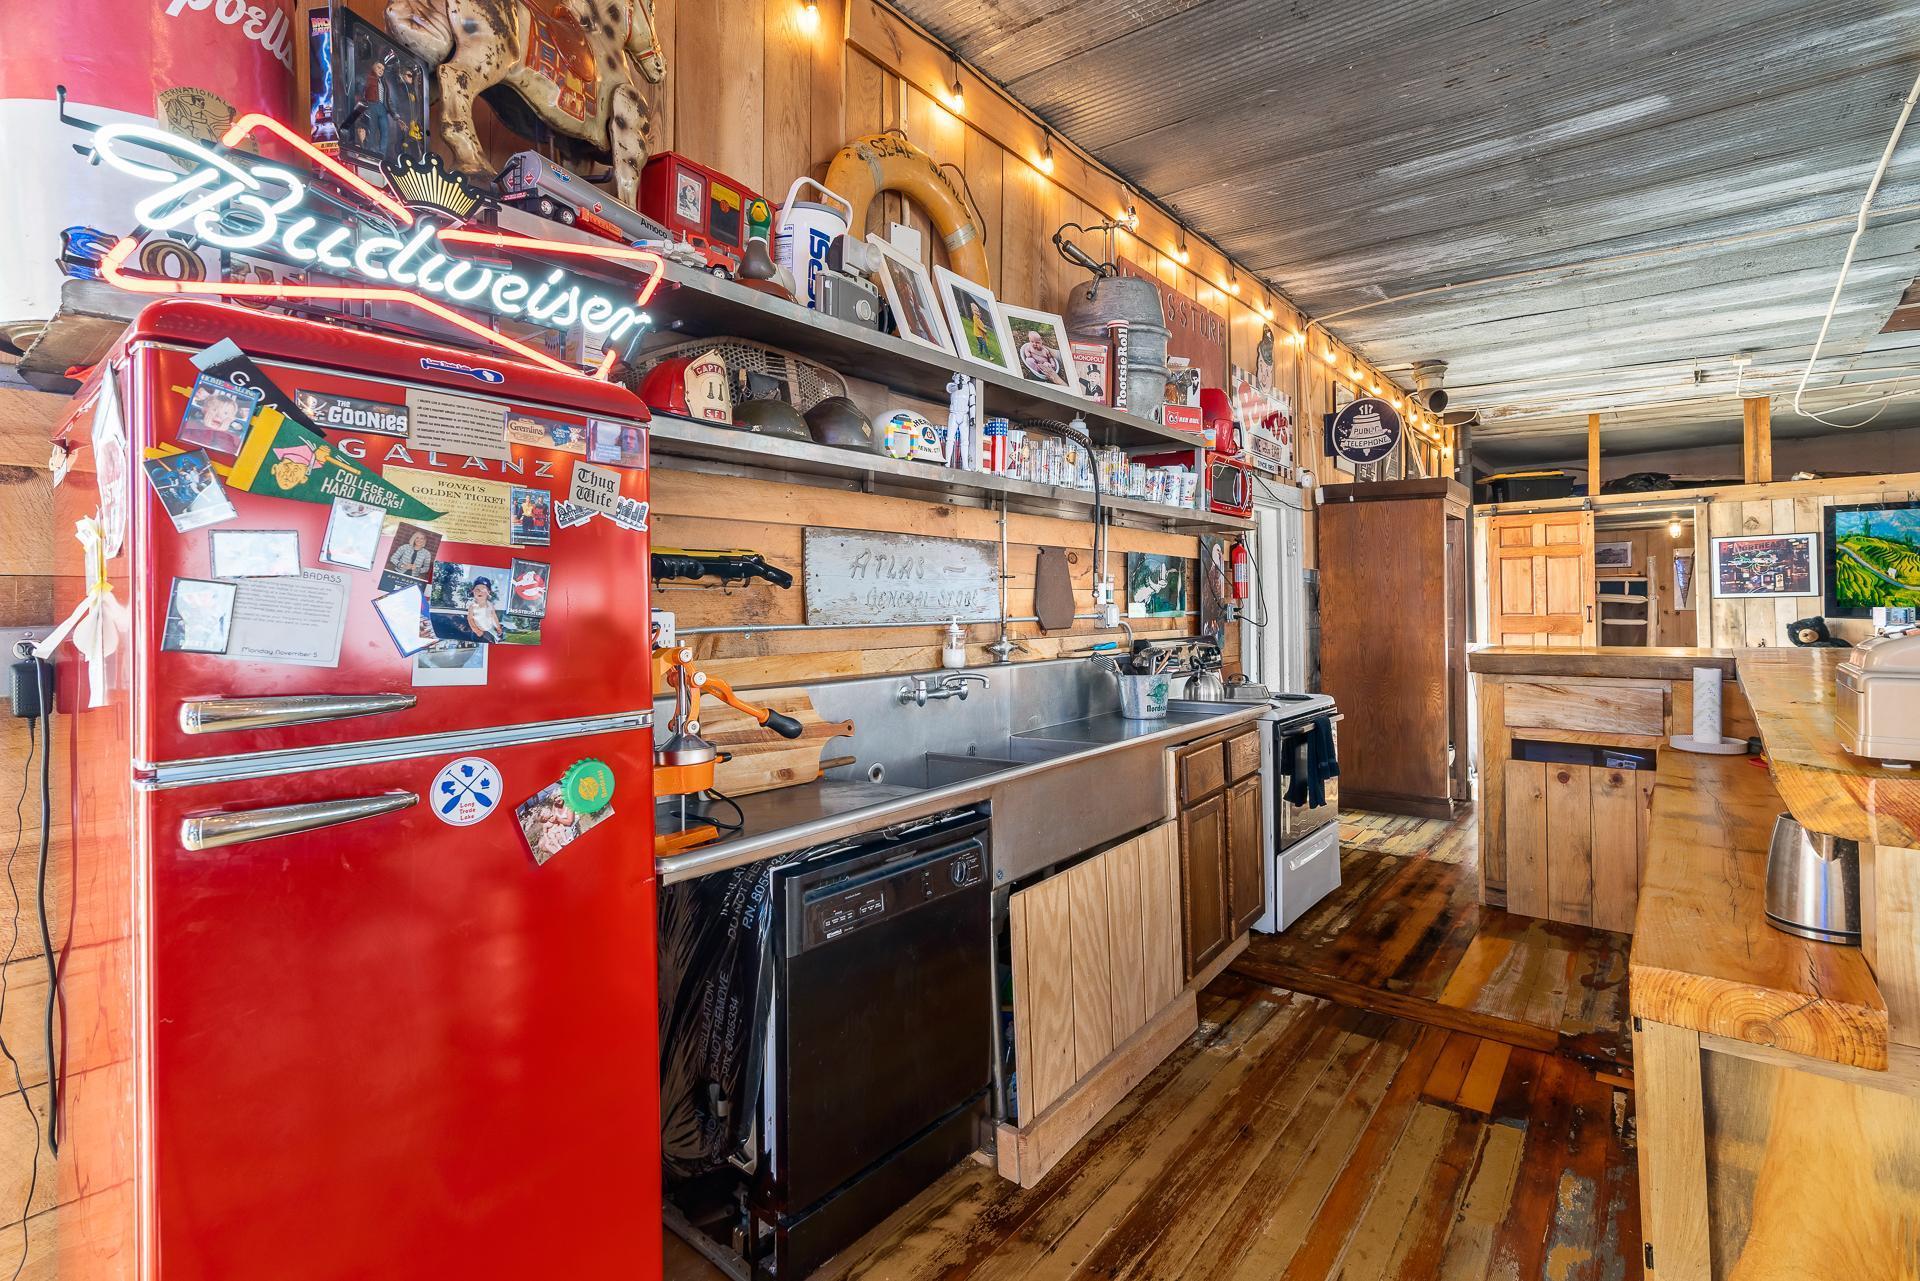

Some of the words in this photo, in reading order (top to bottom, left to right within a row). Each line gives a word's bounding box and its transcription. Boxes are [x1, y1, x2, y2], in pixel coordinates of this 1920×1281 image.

[94, 123, 652, 340] Budweiser
[640, 218, 668, 239] Amoco
[807, 227, 831, 309] EPSI
[1073, 354, 1104, 363] MONOPOLY
[509, 421, 544, 436] Gremlins
[1353, 426, 1380, 434] PUBLIC
[1346, 435, 1388, 448] TELEPHONE
[337, 438, 554, 478] GALANZ
[320, 477, 356, 499] HARD
[335, 468, 385, 497] COLLEGE
[385, 490, 399, 500] OF
[437, 480, 487, 493] WONKA'S
[577, 468, 616, 493] Thug
[411, 486, 462, 499] GOLDEN
[463, 492, 506, 505] TICKET
[576, 486, 613, 508] Wife
[850, 547, 926, 579] ATLAS
[302, 571, 342, 583] BADASS
[241, 646, 274, 655] Monday
[275, 649, 311, 657] November
